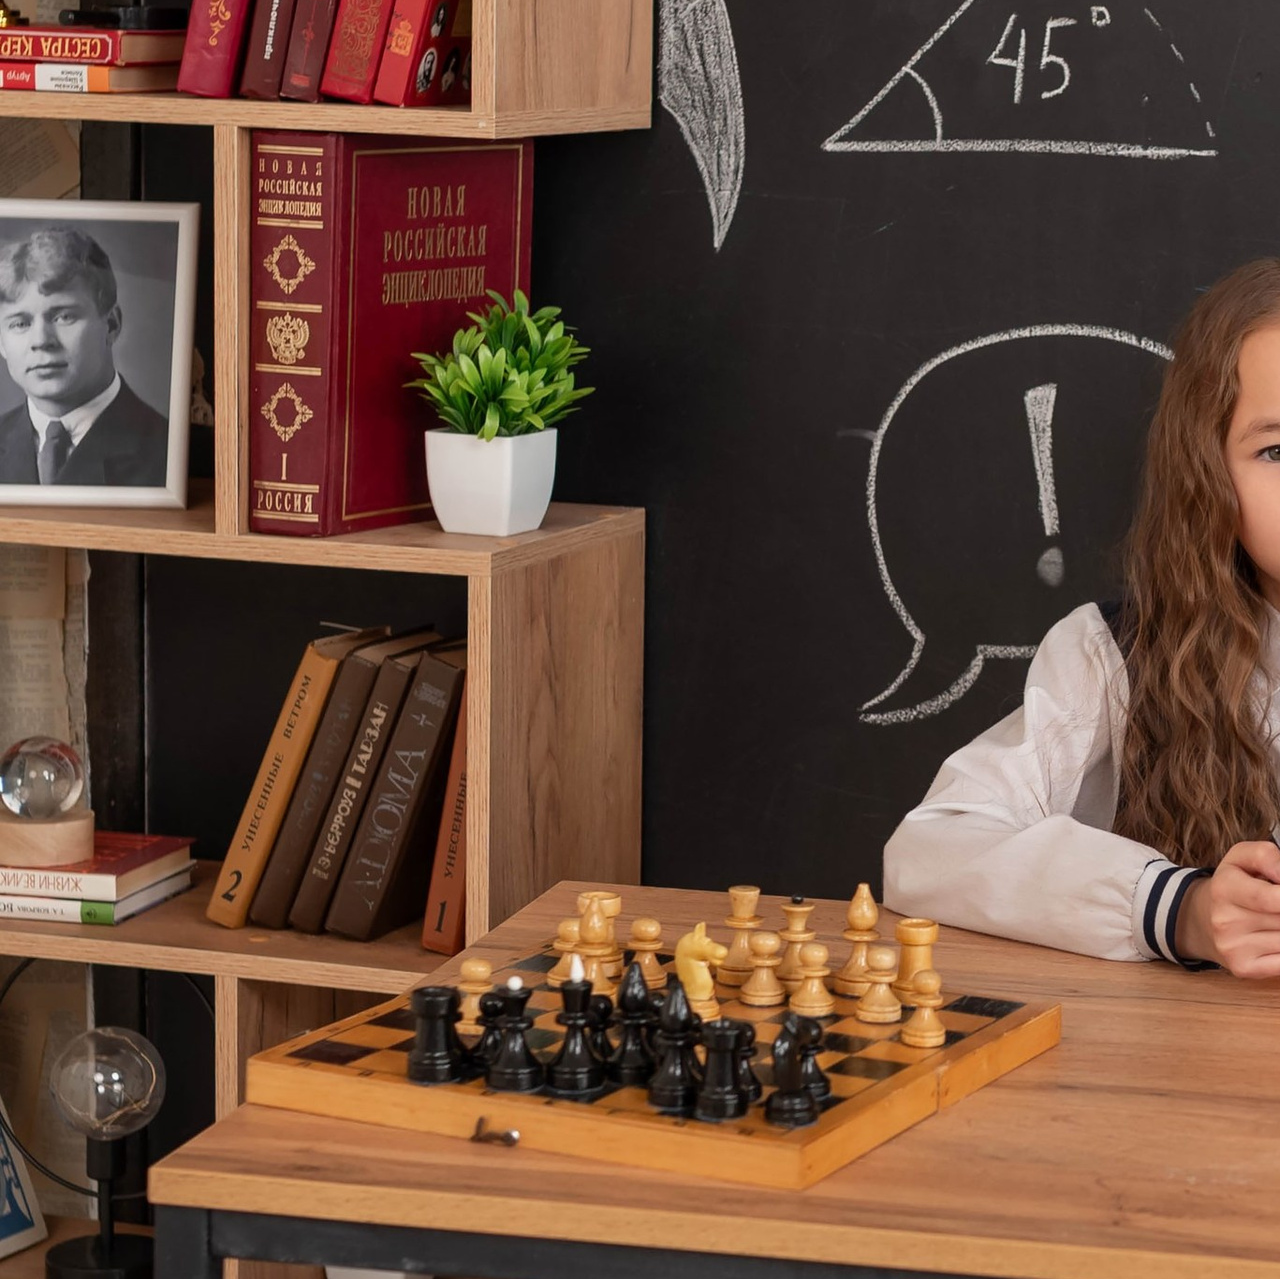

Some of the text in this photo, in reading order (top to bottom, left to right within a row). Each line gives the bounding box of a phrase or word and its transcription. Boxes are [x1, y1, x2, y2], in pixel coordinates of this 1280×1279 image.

[0, 35, 101, 58] СЕСТРА КЕР
[6, 70, 31, 83] Артур
[258, 158, 323, 176] НОВАЯ
[258, 178, 323, 197] РОССИЙСКАЯ
[257, 198, 322, 218] ЭНЦИКЛОПЕДИЯ
[407, 185, 466, 220] НОВАЯ
[383, 225, 487, 265] РОССИЙСКАЯ
[382, 266, 486, 308] ЭНЦИКЛОПЕДИЯ
[256, 488, 314, 516] РОССИЯ
[242, 674, 312, 852] УНЕСЕННЫЕ ВЕТРОМ
[38, 876, 82, 893] ЖИЗНИ
[221, 870, 243, 903] 2
[433, 899, 448, 934] 1
